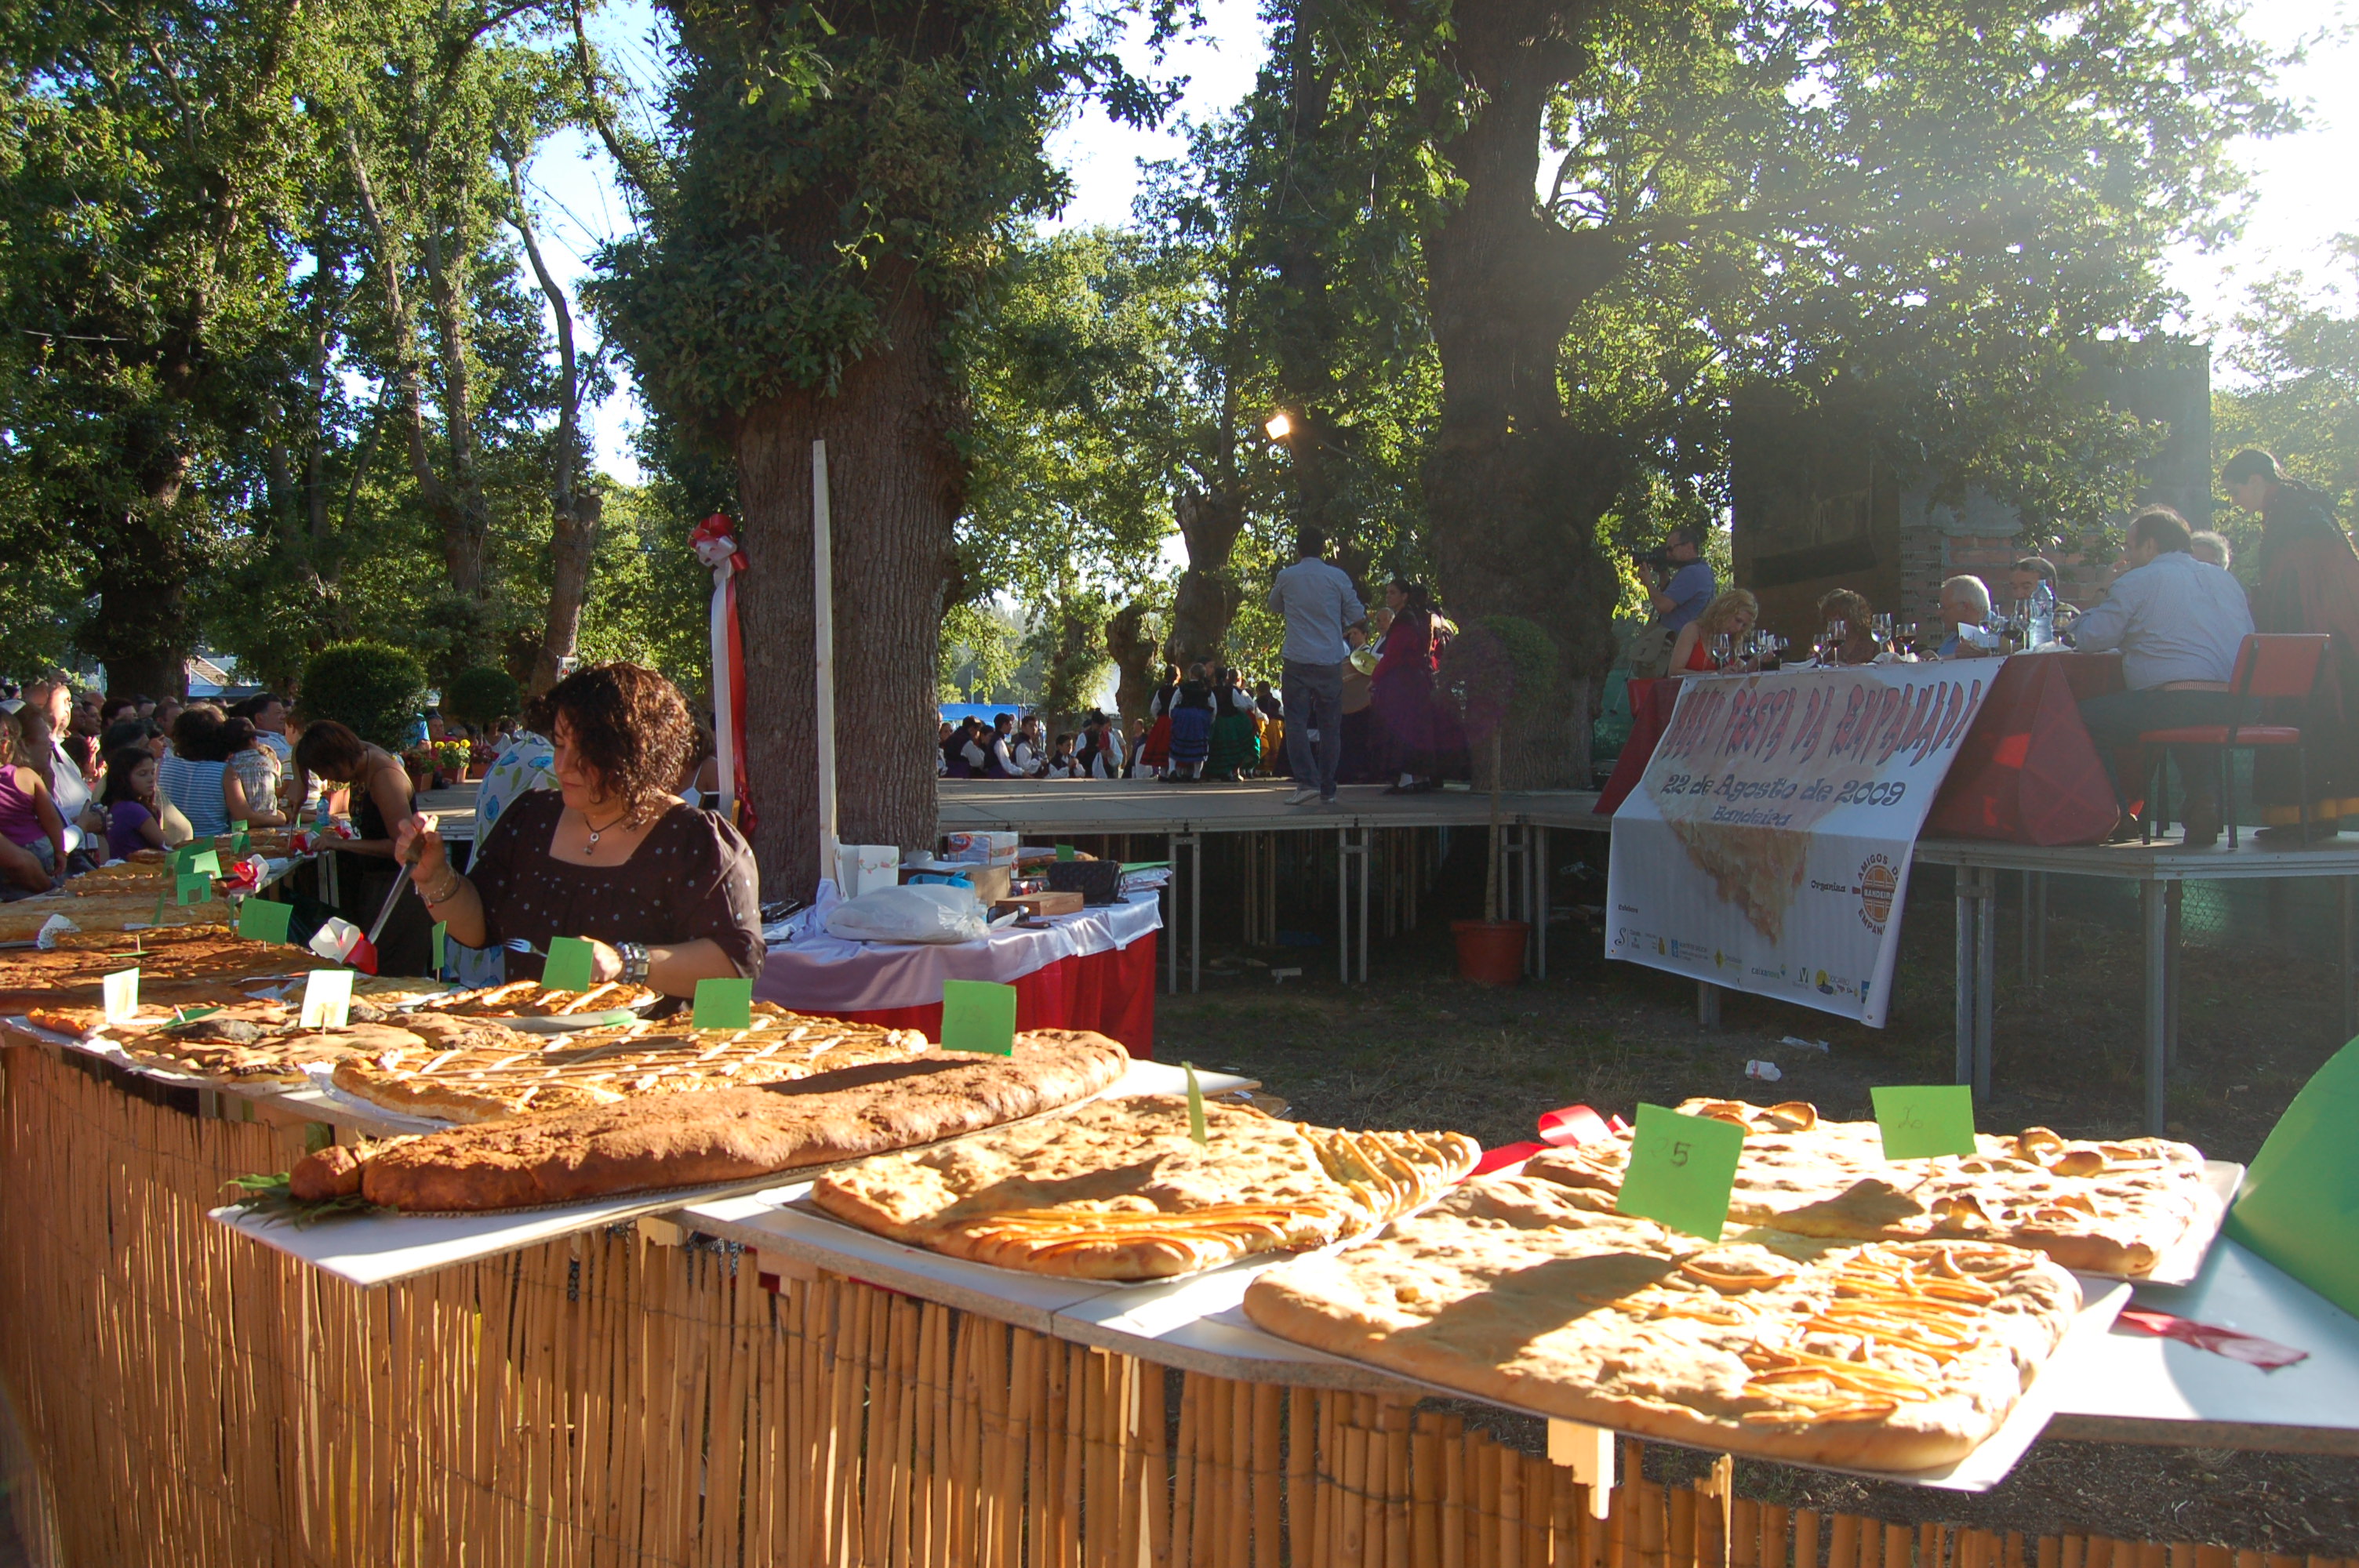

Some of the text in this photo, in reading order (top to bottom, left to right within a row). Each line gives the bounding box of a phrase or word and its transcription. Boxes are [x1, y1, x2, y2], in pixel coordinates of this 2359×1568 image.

[1714, 686, 1797, 764] FESTA
[1789, 684, 1835, 764] DA
[1660, 774, 1907, 807] 22 de Agosto de 2009
[1710, 805, 1794, 827] Bandeira
[1858, 853, 1888, 881] AMIGOS
